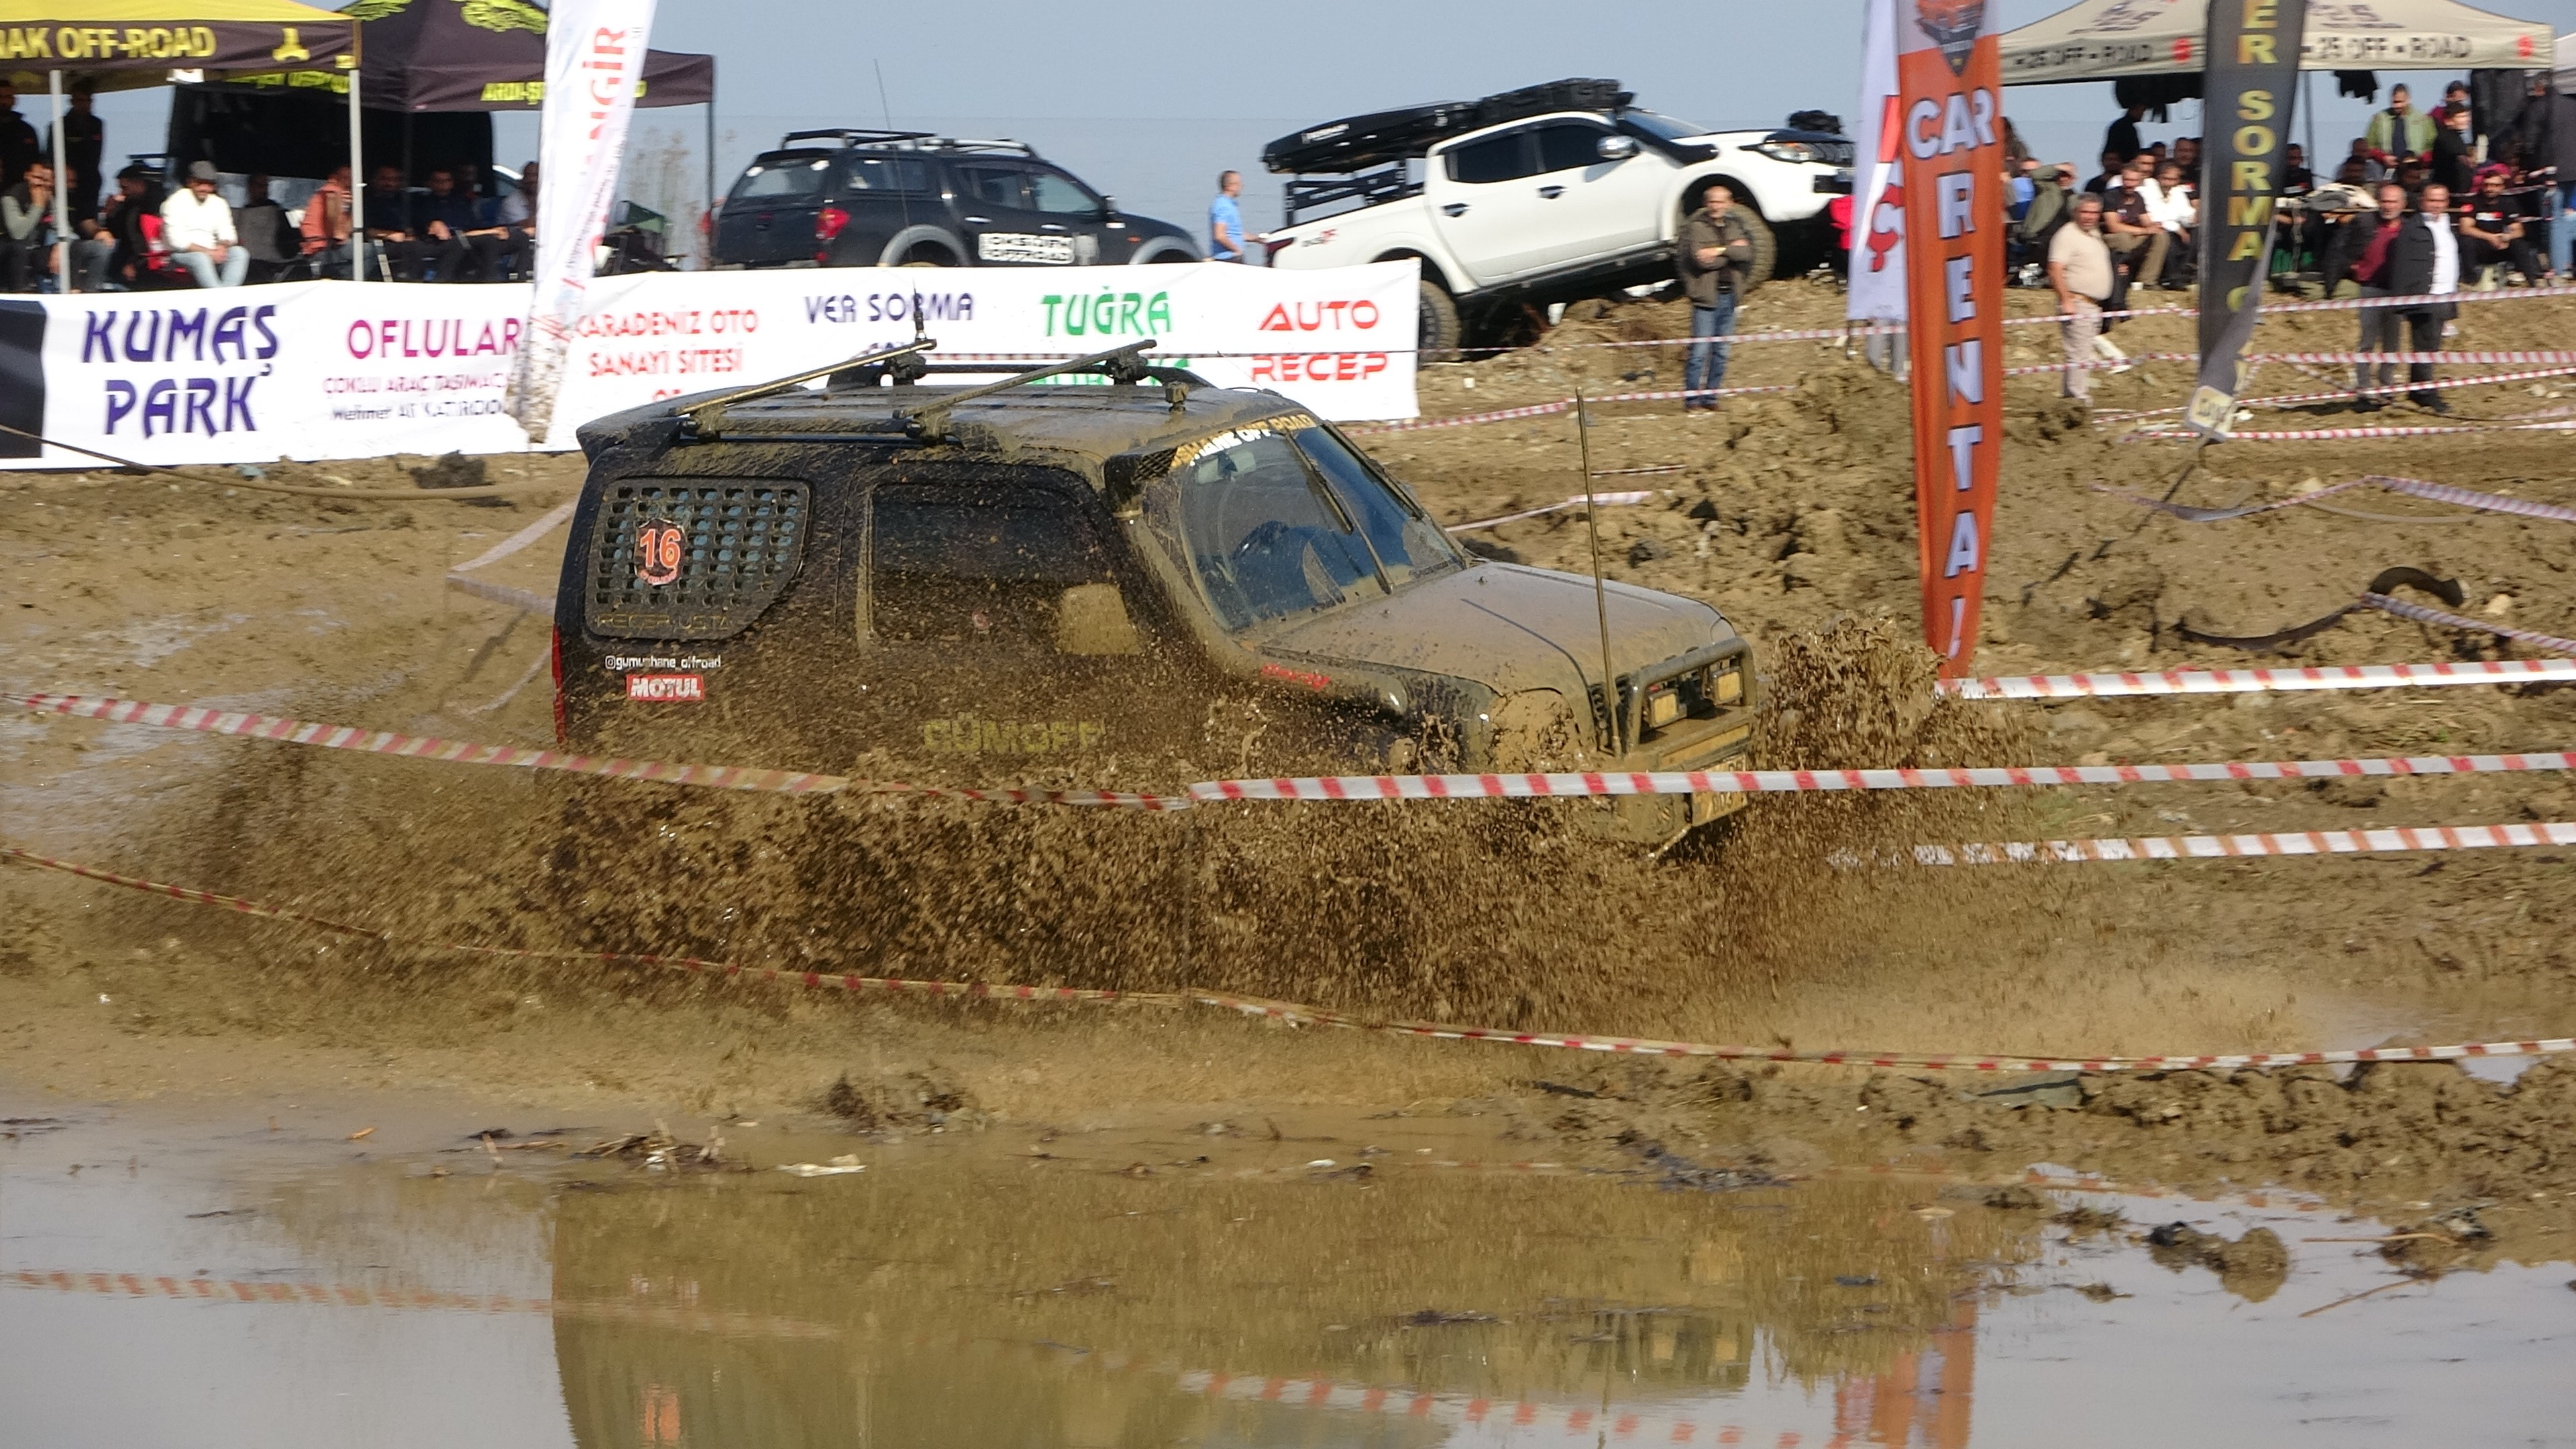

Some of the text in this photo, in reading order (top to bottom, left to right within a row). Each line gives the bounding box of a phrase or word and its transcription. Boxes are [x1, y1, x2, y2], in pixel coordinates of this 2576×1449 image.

[56, 27, 217, 58] OFF-ROAD
[1907, 88, 1997, 160] CAR
[2226, 90, 2277, 261] SORMA
[711, 309, 758, 334] OTO
[805, 294, 857, 323] VER
[1040, 286, 1174, 337] TUĞRA
[1258, 300, 1379, 331] AUTO
[82, 305, 278, 376] KUMAŞ
[348, 318, 521, 359] OFLULAR
[1252, 353, 1387, 382] RECEP
[105, 376, 257, 439] PARK
[639, 528, 681, 568] 16
[630, 678, 701, 698] MOTUL
